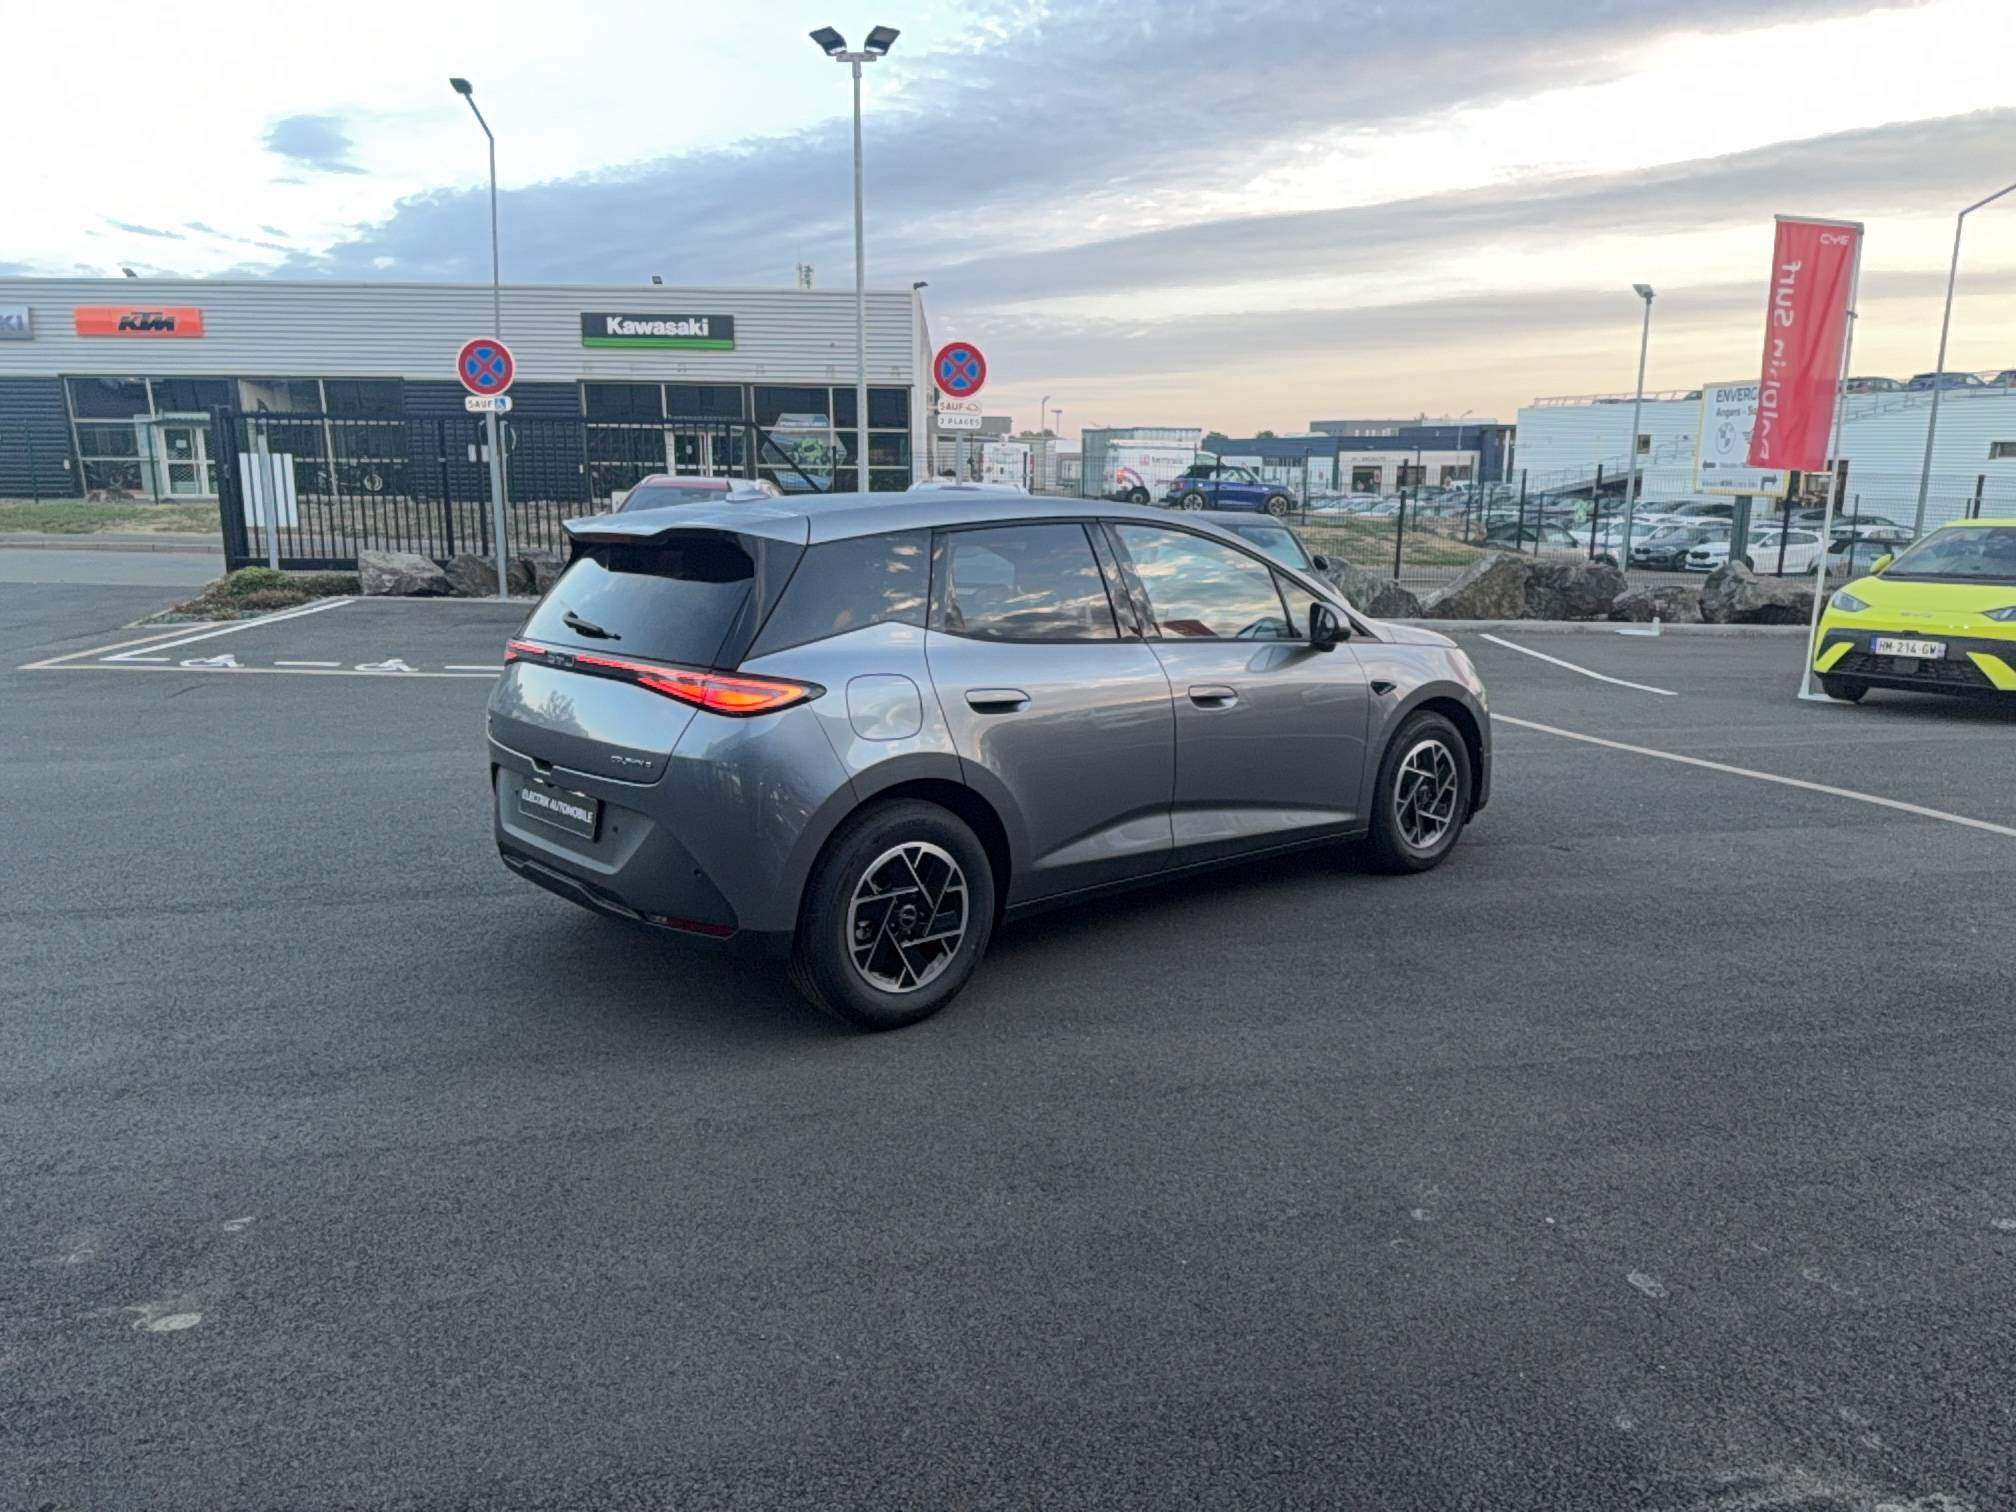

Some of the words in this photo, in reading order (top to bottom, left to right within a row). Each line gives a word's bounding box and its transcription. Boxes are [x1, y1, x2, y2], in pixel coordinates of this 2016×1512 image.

[118, 311, 176, 331] KTM
[606, 316, 709, 336] Kawasaki
[468, 399, 493, 409] SAUF
[940, 402, 964, 411] SAUF
[948, 417, 981, 426] PLACES
[549, 798, 593, 824] AUTOMOBILE
